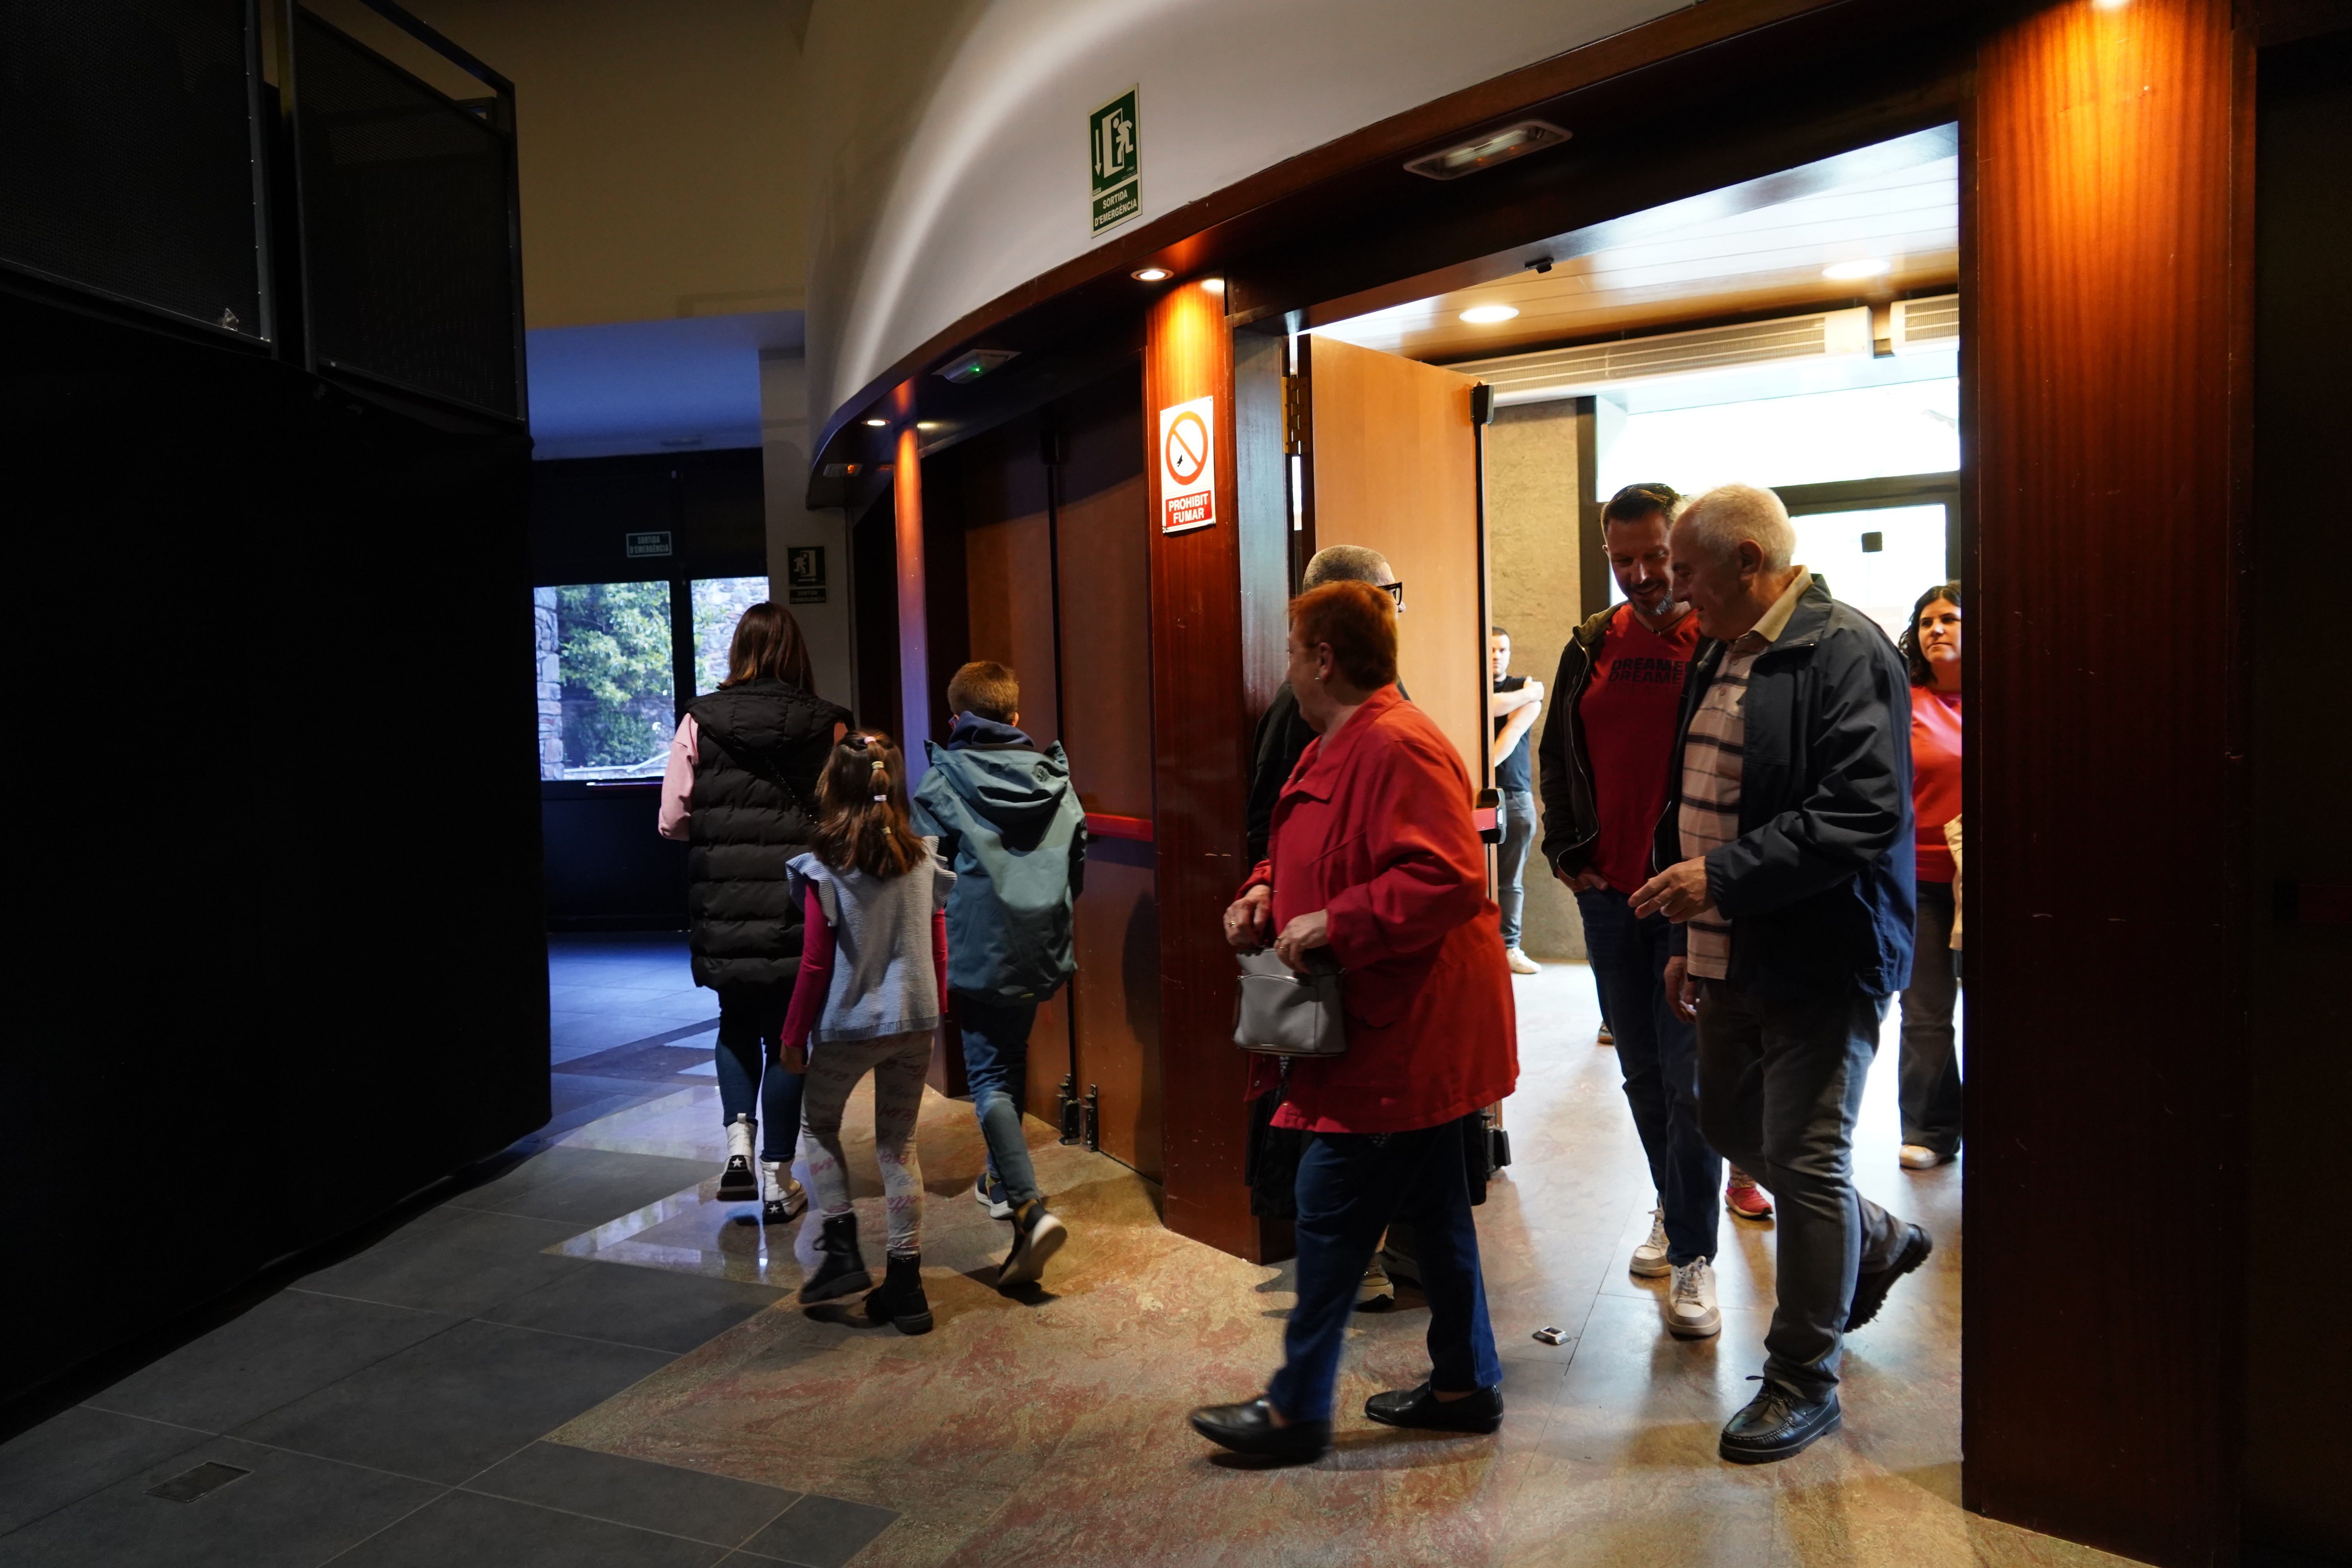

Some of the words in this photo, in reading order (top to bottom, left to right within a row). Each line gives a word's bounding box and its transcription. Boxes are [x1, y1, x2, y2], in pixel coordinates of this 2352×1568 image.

[1103, 189, 1128, 209] SORTIDA
[1094, 198, 1137, 227] D'EMERGÈNCIA
[1169, 493, 1209, 512] PROHIBIT
[1173, 507, 1204, 524] FUMAR
